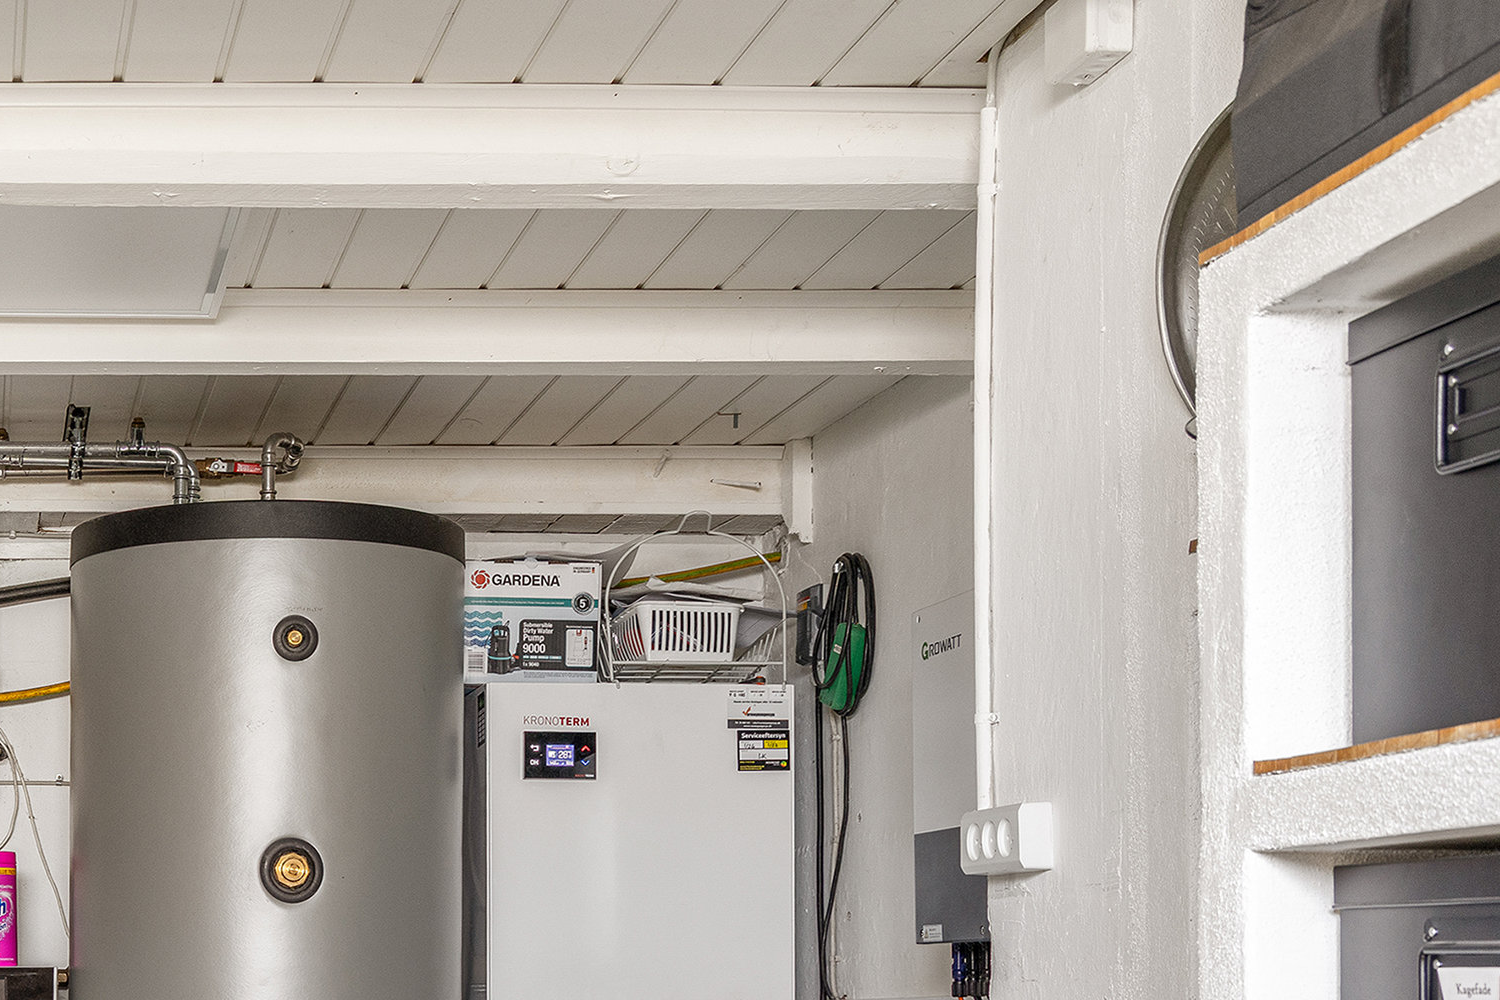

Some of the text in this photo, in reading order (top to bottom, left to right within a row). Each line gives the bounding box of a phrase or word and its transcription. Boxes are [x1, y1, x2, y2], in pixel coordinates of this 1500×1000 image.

[491, 574, 561, 587] GARDENA
[579, 598, 586, 608] 5
[522, 634, 545, 643] Pump
[522, 643, 546, 653] 9000
[921, 633, 962, 661] GROWATT
[523, 715, 590, 727] KRONOTERM
[1455, 982, 1492, 999] Kagefade
